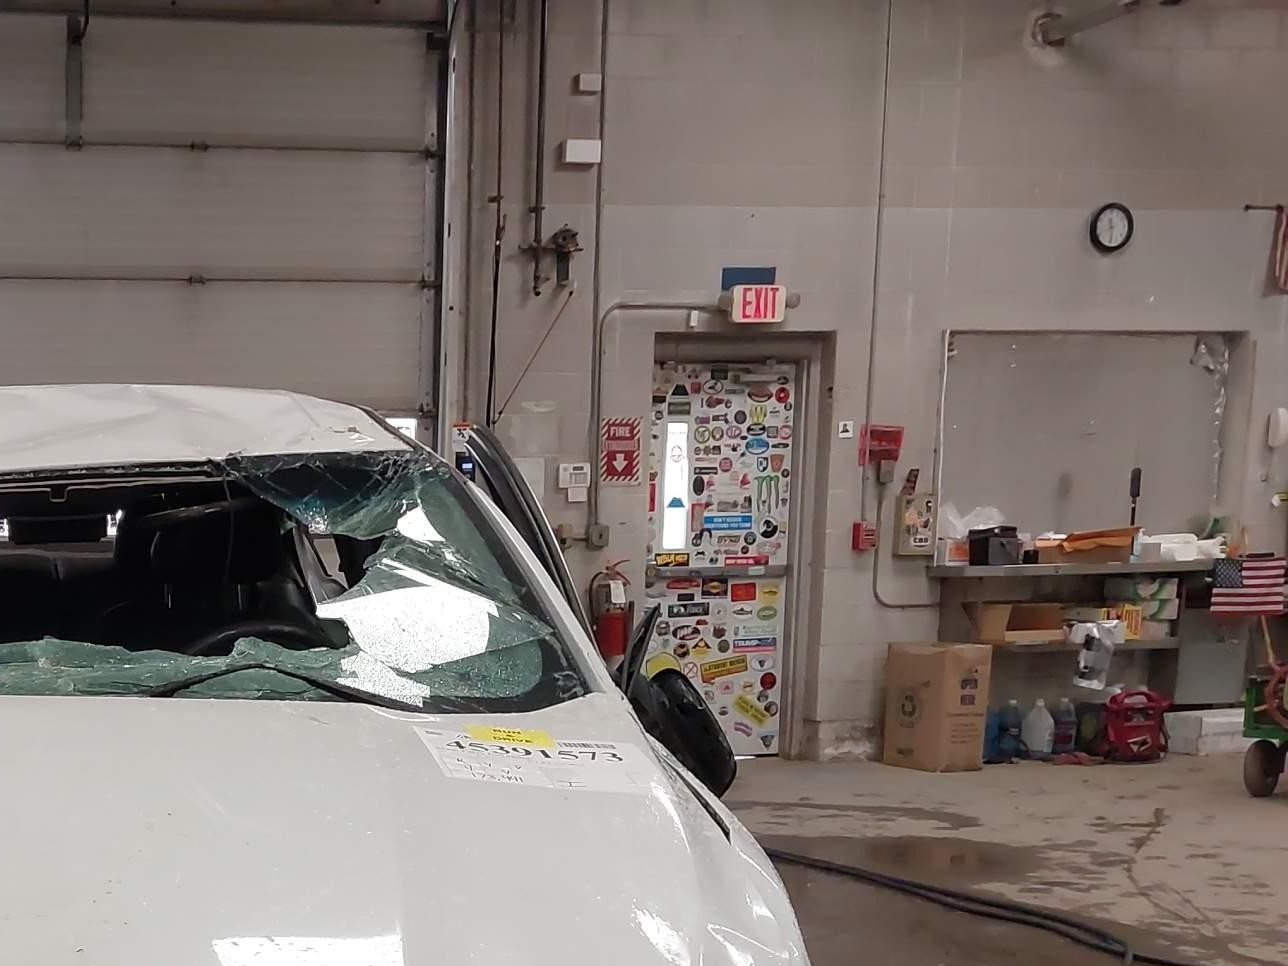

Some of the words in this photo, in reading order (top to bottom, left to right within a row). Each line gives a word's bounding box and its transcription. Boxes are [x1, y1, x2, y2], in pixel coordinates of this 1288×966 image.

[742, 287, 779, 319] EXIT
[610, 426, 632, 438] FIRE
[492, 735, 534, 744] DRIVE
[446, 740, 624, 763] 45391573
